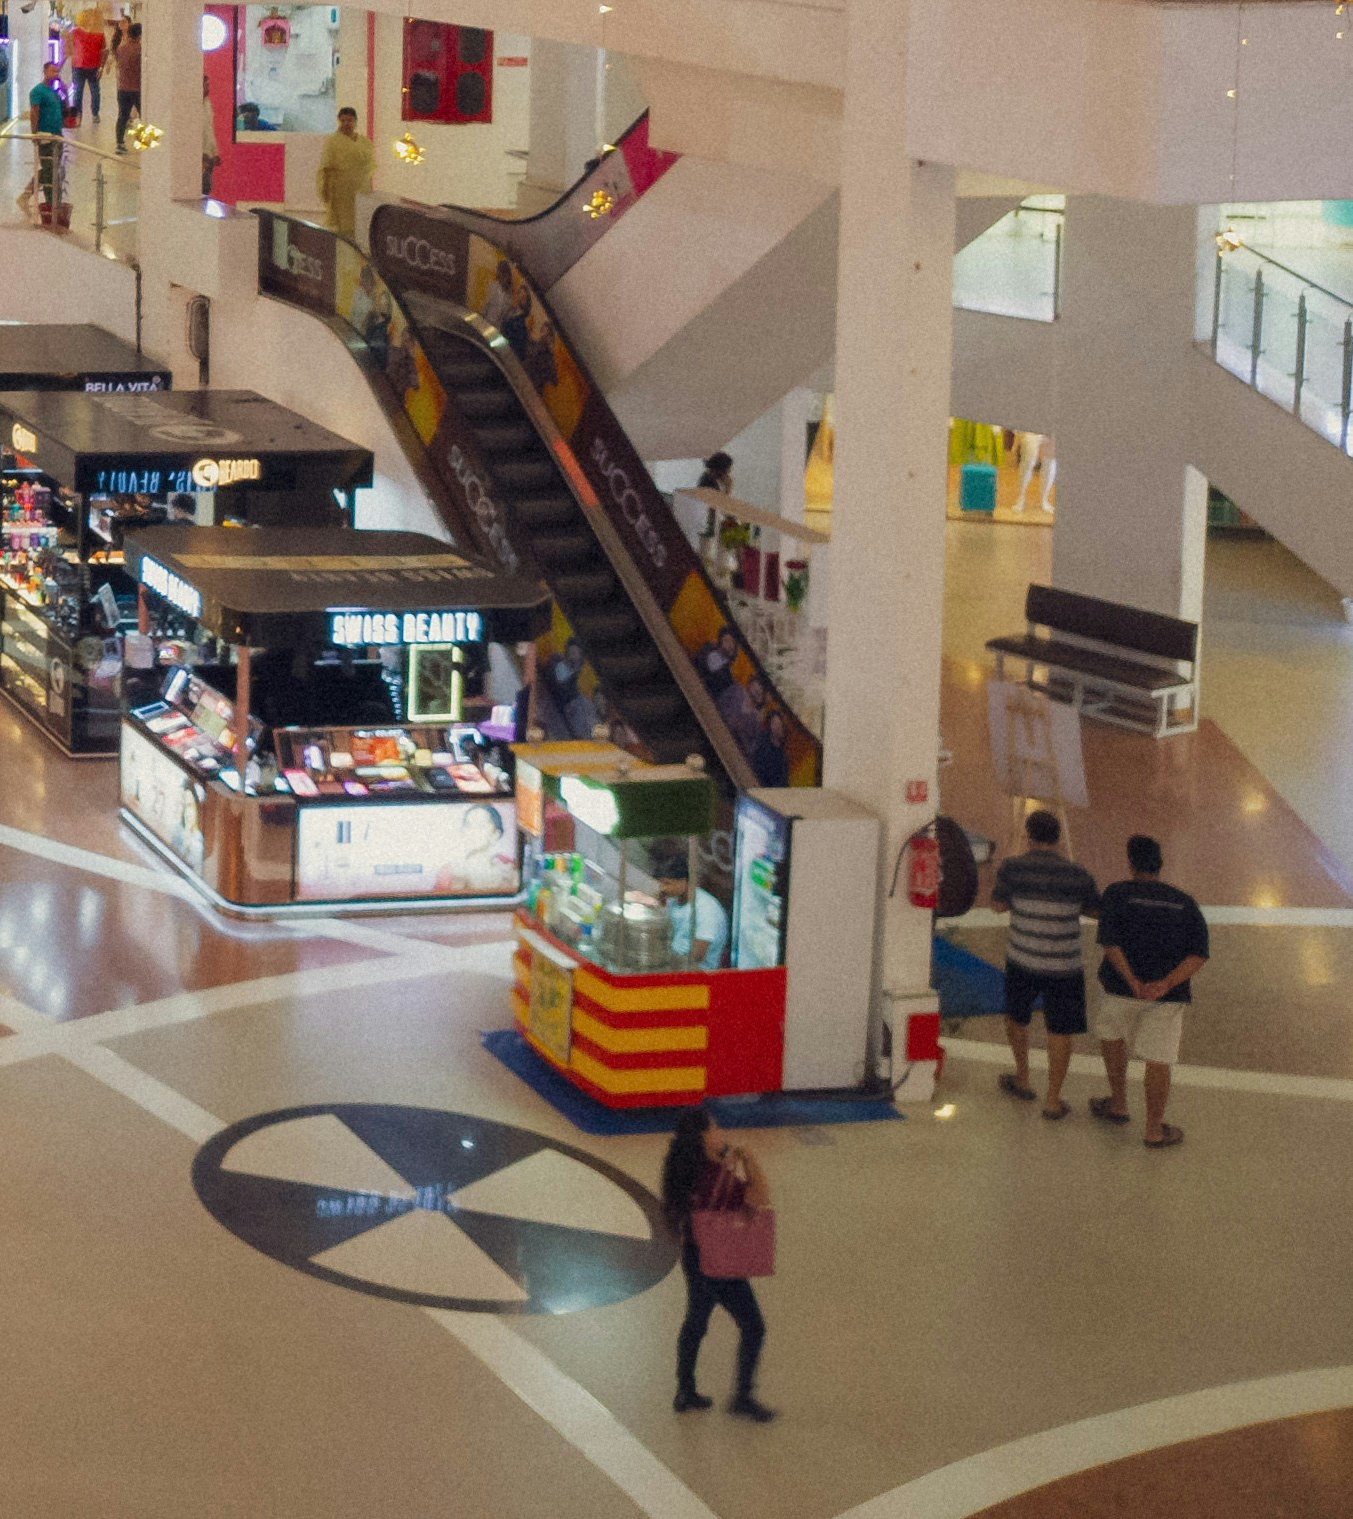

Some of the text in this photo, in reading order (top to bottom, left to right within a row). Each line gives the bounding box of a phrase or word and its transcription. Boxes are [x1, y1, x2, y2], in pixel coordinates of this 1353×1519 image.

[386, 235, 457, 275] SUCCESS
[332, 612, 482, 644] SWISS BEAUTY
